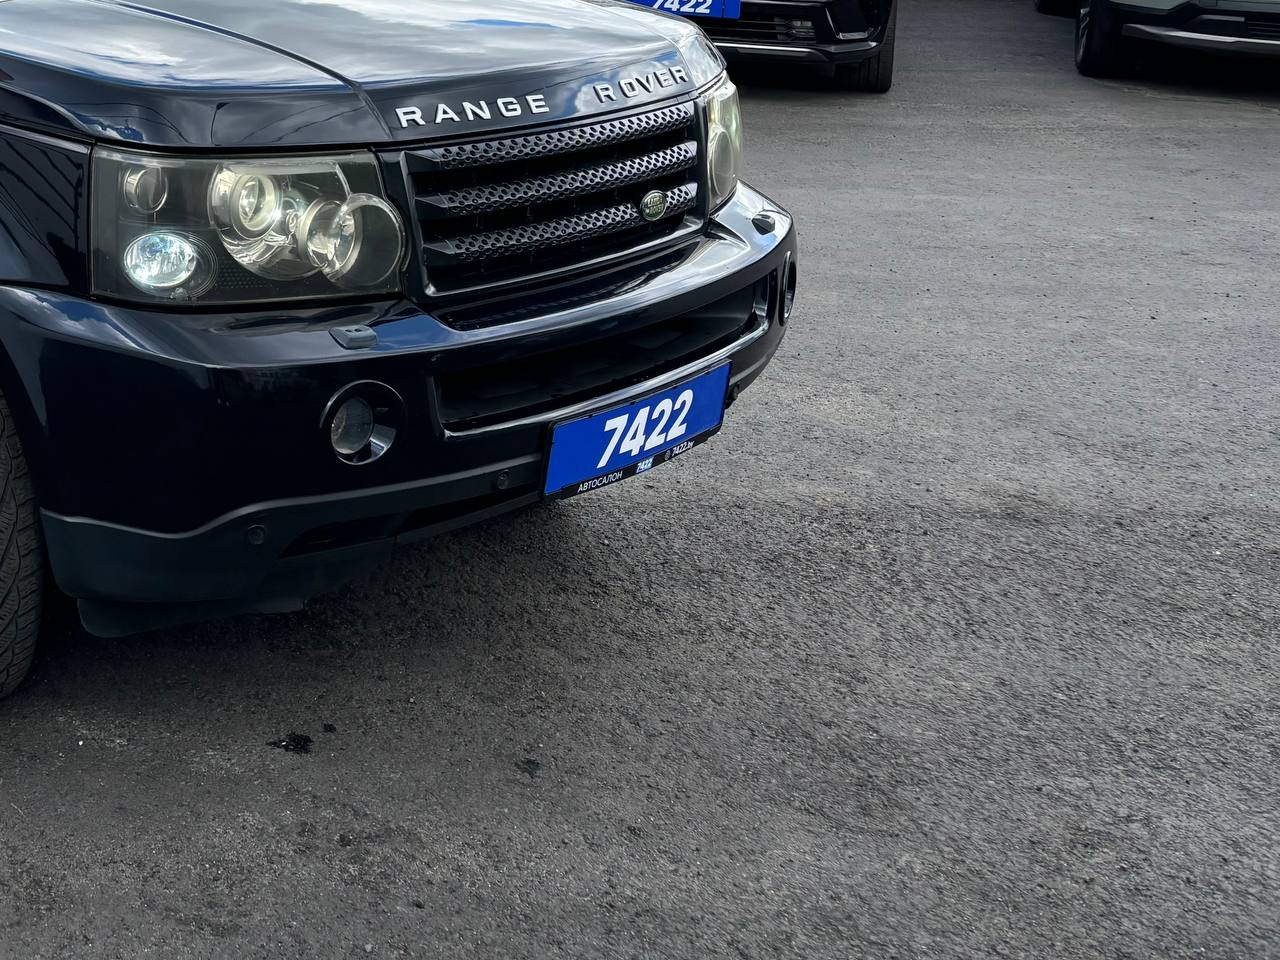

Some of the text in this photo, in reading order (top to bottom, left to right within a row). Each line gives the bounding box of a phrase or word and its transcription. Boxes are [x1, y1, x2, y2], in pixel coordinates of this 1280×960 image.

[395, 65, 689, 128] RANGE ROVER
[596, 389, 694, 469] 7422
[577, 471, 623, 493] АВТОСАЛОН
